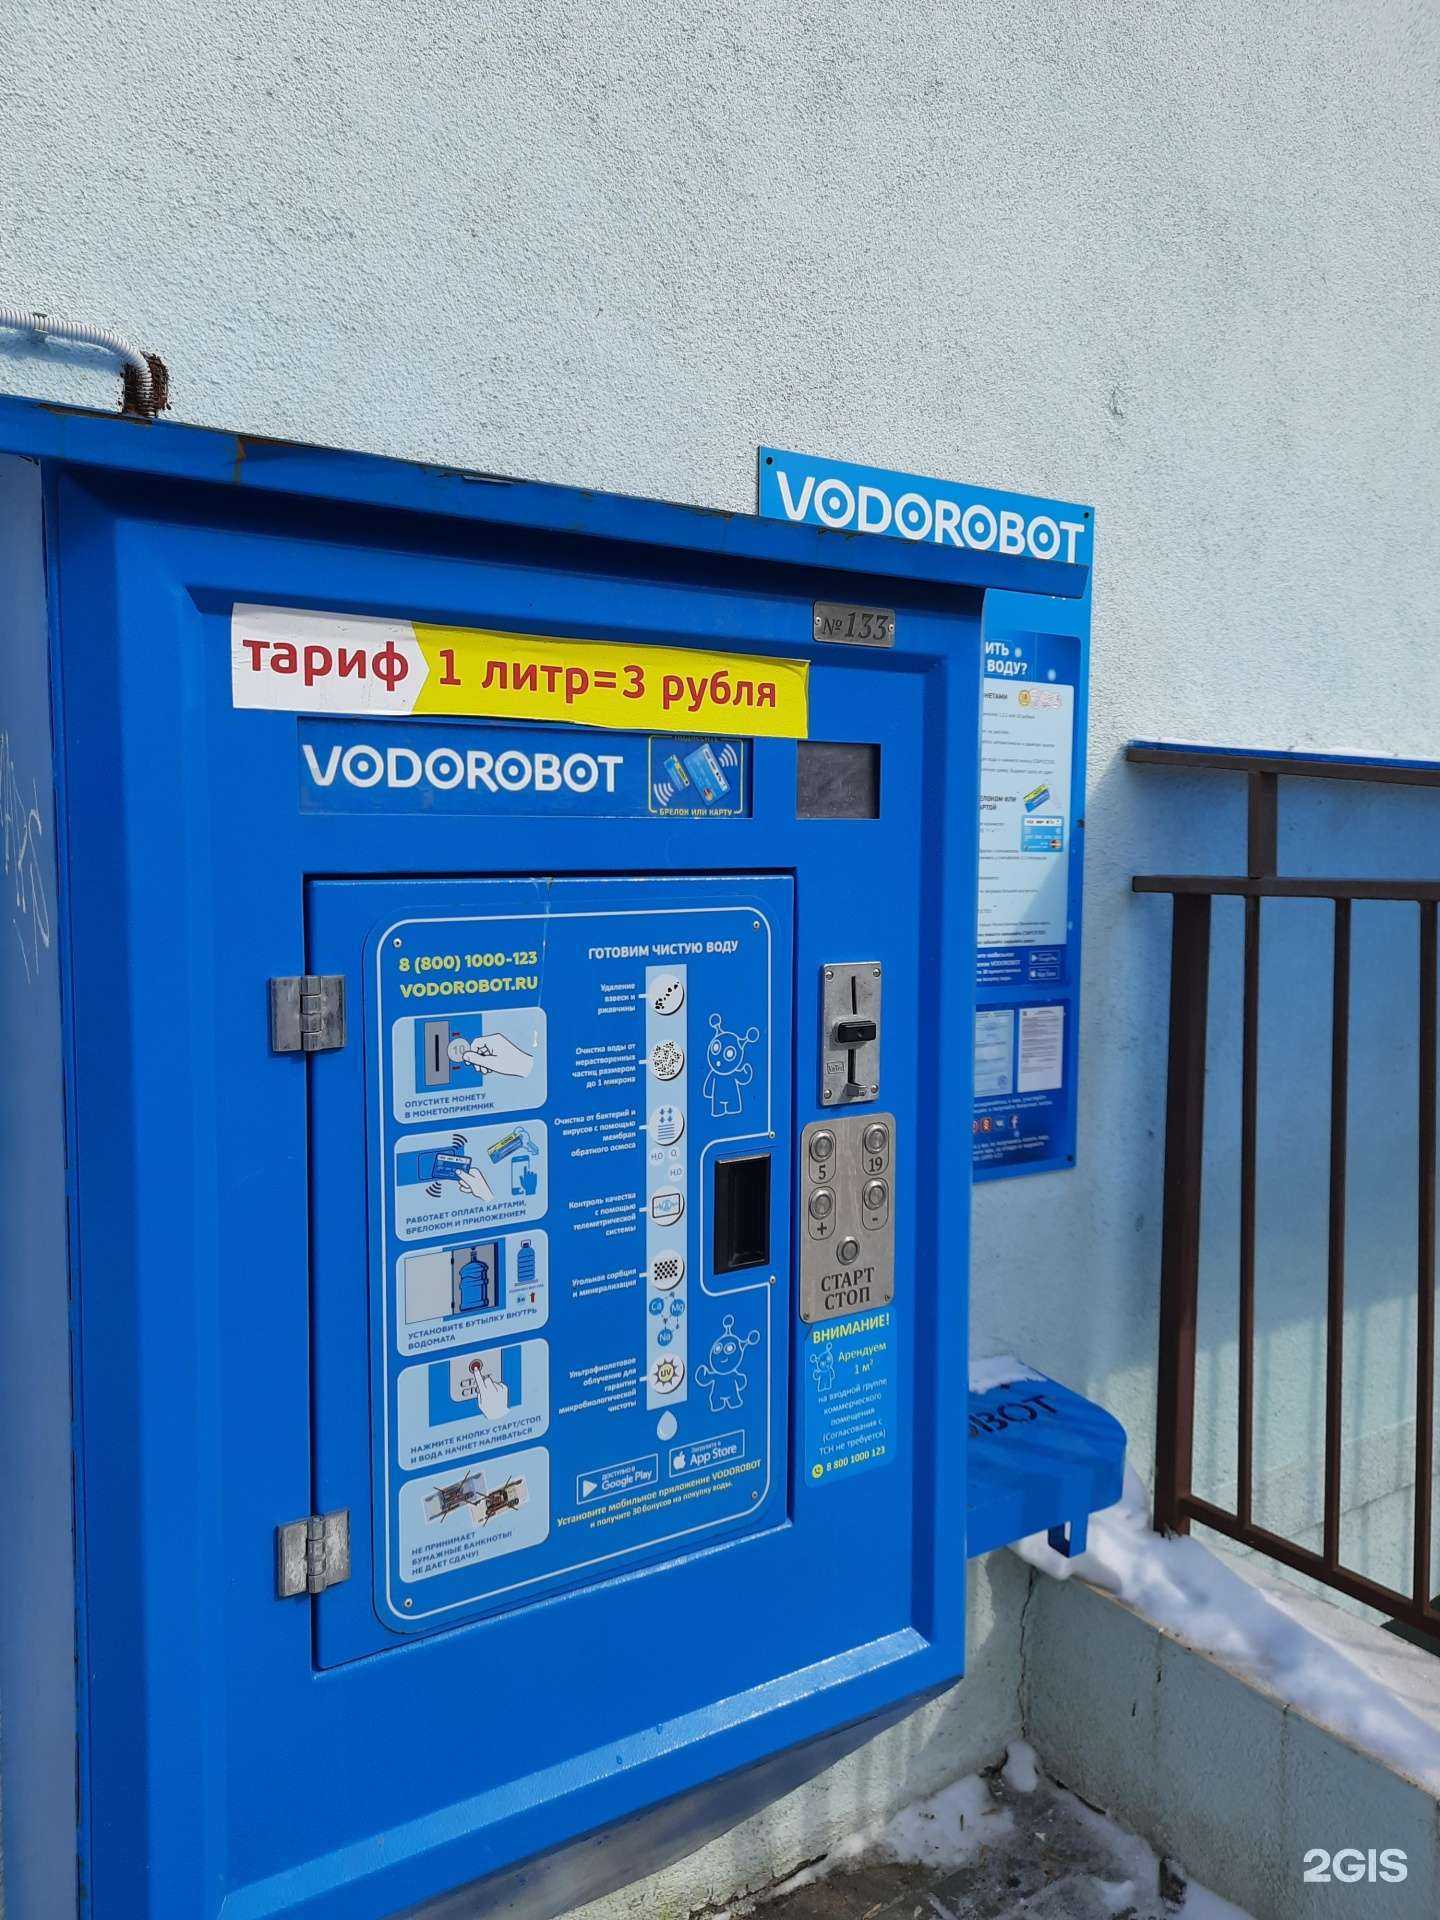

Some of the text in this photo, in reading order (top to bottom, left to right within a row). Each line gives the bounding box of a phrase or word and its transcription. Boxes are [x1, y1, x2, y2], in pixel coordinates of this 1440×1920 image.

[776, 471, 1085, 563] VODOROBOT
[846, 611, 890, 640] 133
[985, 641, 1010, 656] ИТЬ
[242, 639, 776, 712] тариф 1 литр=3 рубля
[986, 659, 1028, 676] ВОДУ?
[984, 692, 1008, 700] НЕТАМИ
[301, 744, 624, 792] VODOROBOT
[659, 808, 732, 817] БРЕЛОК ИЛИ КАРТУ
[588, 940, 739, 960] ГОТОВИМ ЧИСТУЮ ВОДУ
[398, 951, 538, 974] 8 (800) 1000-123
[400, 976, 539, 998] VODOROBOT.RU
[600, 983, 636, 992] Удаление
[604, 994, 629, 1002] взвеси
[597, 1005, 636, 1015] ржавчины
[575, 1045, 606, 1055] Очистка
[608, 1043, 626, 1052] воды
[575, 1055, 636, 1066] нерастворенных
[572, 1066, 636, 1078] частиц размером
[586, 1080, 596, 1088] до
[603, 1077, 636, 1087] микрона
[404, 1093, 487, 1109] ОПУСТИТЕ МОНЕТУ
[404, 1102, 494, 1119] В МОНЕТОПРИЕМНИК
[554, 1116, 585, 1126] Очистка
[595, 1109, 630, 1121] бактерий
[562, 1127, 593, 1136] вирусов
[600, 1120, 636, 1131] помощью
[602, 1131, 636, 1142] мембран
[571, 1142, 636, 1157] обратного осмоса
[818, 1156, 883, 1180] 5 19
[568, 1192, 636, 1209] Контроль качества
[600, 1204, 636, 1215] помощью
[406, 1200, 527, 1225] РАБОТАЕТ ОПЛАТА КАРТАМИ,
[406, 1210, 526, 1235] БРЕЛОКОМ И ПРИЛОЖЕНИЕМ
[605, 1225, 636, 1237] системы
[571, 1268, 637, 1287] Угольная сорбция
[821, 1267, 875, 1292] СТАРТ
[579, 1280, 637, 1297] минерализация
[824, 1287, 870, 1310] СТОП
[408, 1309, 537, 1340] УСТАНОВИТЕ БУТЫЛКУ ВНУТРЬ
[812, 1312, 890, 1344] ВНИМАНИЕ!
[408, 1335, 456, 1350] ВОДОМАТА
[838, 1342, 887, 1363] Арендуем
[569, 1358, 637, 1379] Ультрафиолетовое
[583, 1368, 637, 1387] облучение для
[661, 1368, 672, 1378] UV
[854, 1364, 859, 1375] 1
[604, 1379, 637, 1392] гарантии
[818, 1377, 888, 1404] на входной группе
[558, 1389, 637, 1415] микробиологической
[608, 1401, 637, 1413] чистоты
[823, 1392, 882, 1415] коммерческого
[830, 1408, 875, 1427] помещения
[410, 1415, 541, 1453] НАЖМИТЕ КНОПКУ СТАРТ/СТОП
[818, 1429, 886, 1456] ТСН не требуется)
[418, 1451, 443, 1463] ВОДА
[444, 1442, 478, 1456] НАЧНЕТ
[479, 1427, 533, 1447] НАЛИВАТЬСЯ
[690, 1444, 737, 1466] App Store
[826, 1445, 886, 1472] 8 800 1000 123
[601, 1470, 653, 1491] Google Play
[557, 1459, 762, 1528] Установите мобильное приложение VODOROBOT
[596, 1511, 631, 1526] получите
[632, 1507, 643, 1516] 30
[643, 1498, 672, 1514] бонусов
[683, 1488, 712, 1502] покупку
[411, 1531, 476, 1555] НЕ ПРИНИМАЕТ
[411, 1547, 462, 1566] БУМАЖНЫЕ
[411, 1551, 479, 1576] НЕ ДАЕТ СДАЧУ!
